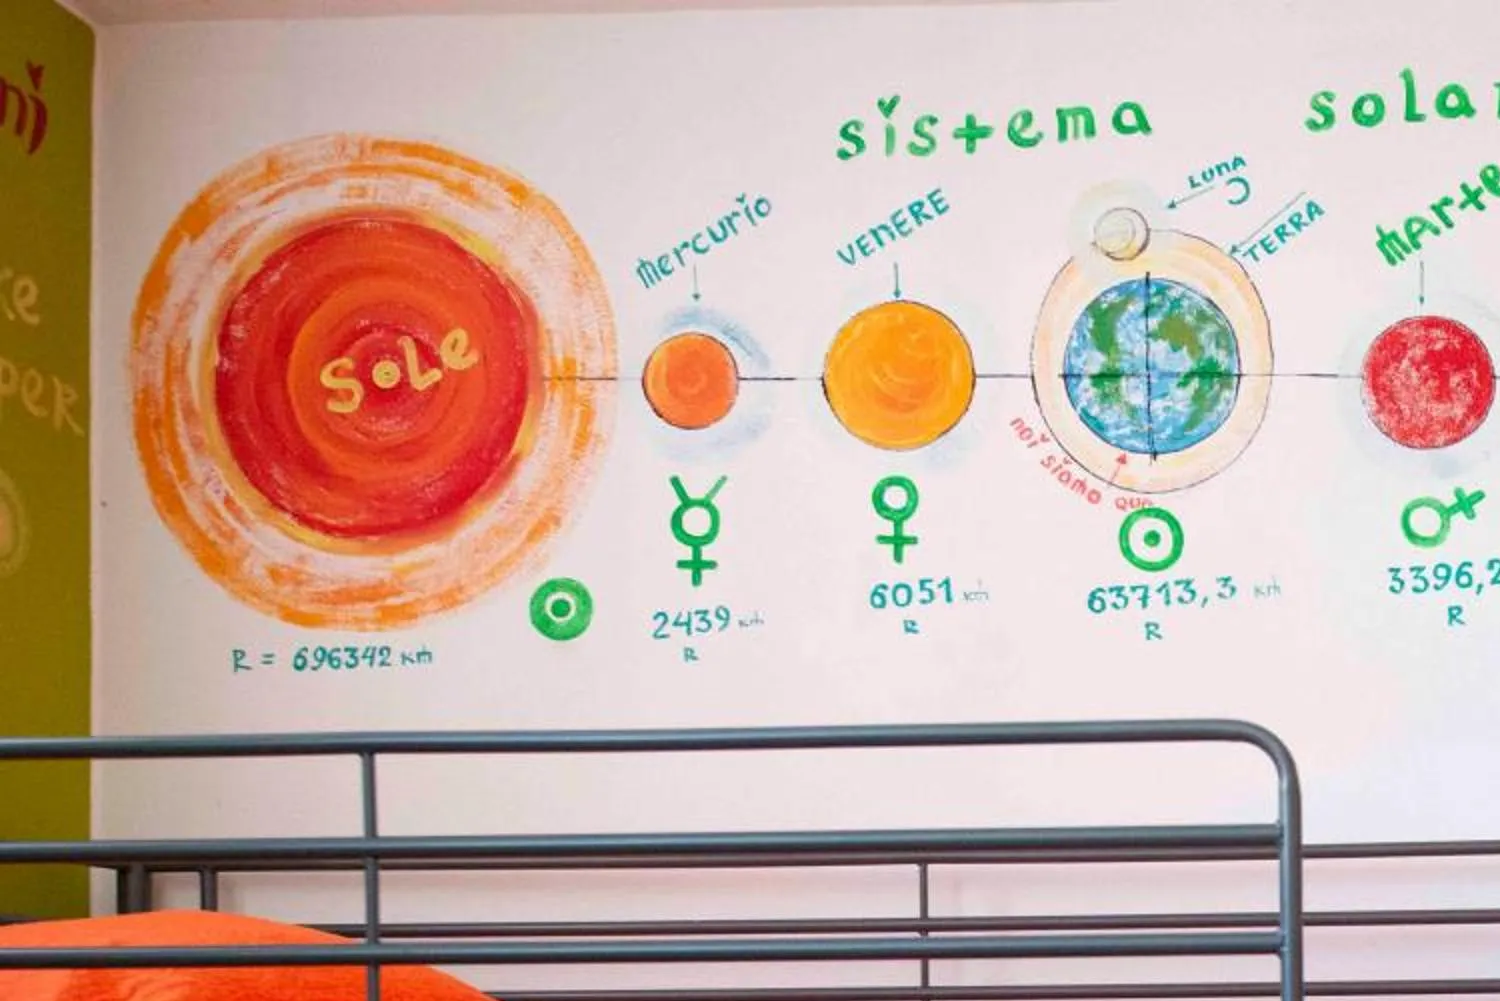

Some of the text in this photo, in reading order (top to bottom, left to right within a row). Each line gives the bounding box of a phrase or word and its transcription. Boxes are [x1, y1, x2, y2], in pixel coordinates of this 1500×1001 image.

[833, 95, 1154, 161] sistema
[1241, 199, 1326, 263] TERRA
[867, 576, 956, 609] 6051
[1087, 572, 1238, 615] 63713,3
[650, 607, 731, 641] 2439
[901, 619, 920, 634] R
[1446, 602, 1464, 627] R
[1144, 621, 1161, 640] R
[231, 649, 250, 672] R
[292, 645, 390, 672] 696342
[681, 647, 696, 662] R
